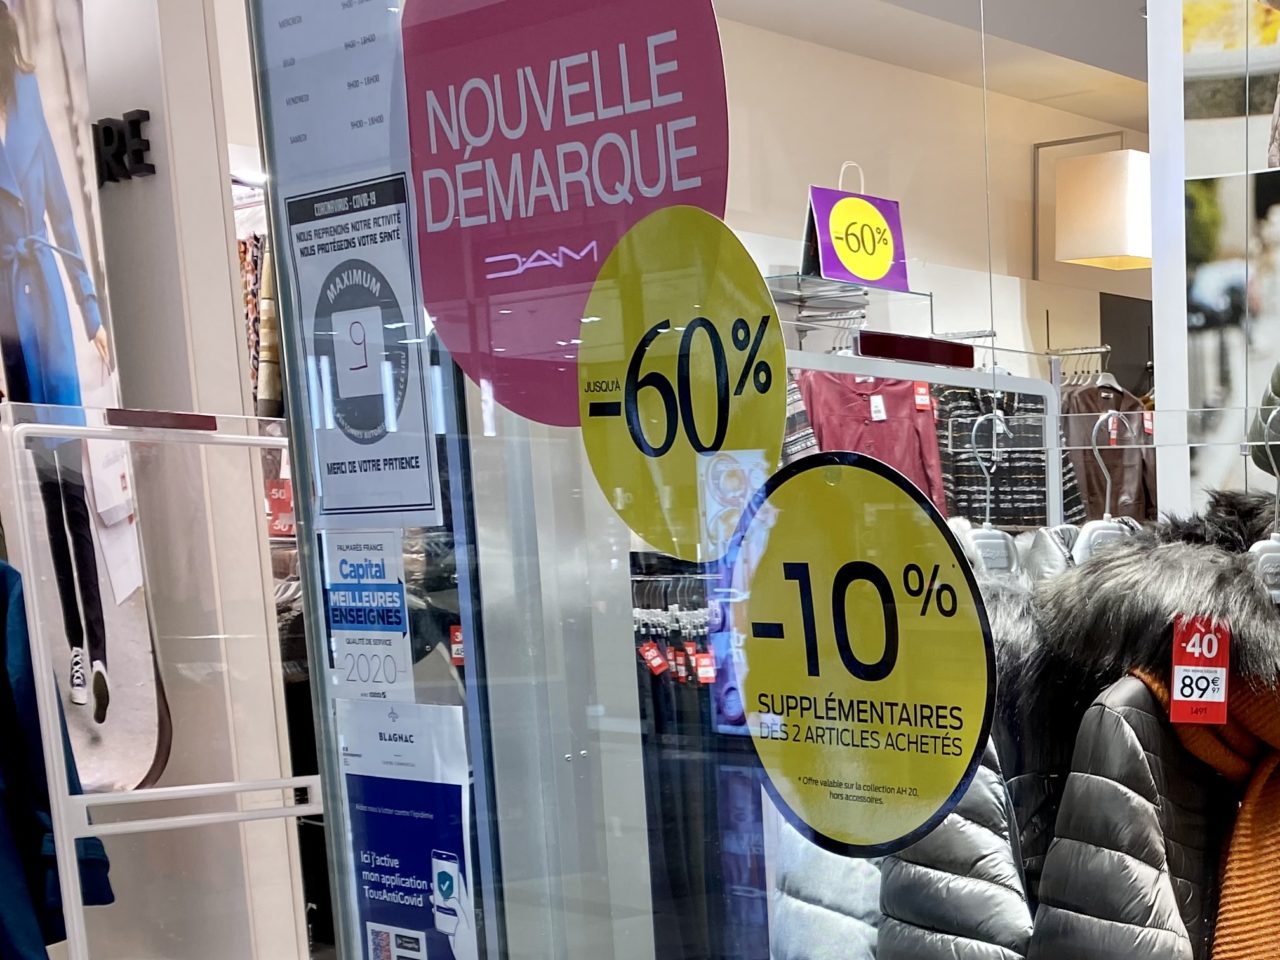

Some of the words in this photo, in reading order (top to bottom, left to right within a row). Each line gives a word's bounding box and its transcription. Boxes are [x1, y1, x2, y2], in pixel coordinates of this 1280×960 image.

[425, 29, 683, 155] NOUVELLE
[92, 108, 156, 189] RE
[422, 115, 702, 233] DÉMARQUE
[314, 197, 349, 217] CORONAVIRUS
[353, 191, 377, 209] COVID-19
[296, 230, 313, 243] NOUS
[314, 223, 350, 239] REPRENONS
[351, 218, 372, 232] NOTRE
[373, 209, 401, 228] ACTIVITÉ
[834, 221, 888, 257] -60%
[300, 245, 316, 257] NOUS
[317, 238, 356, 254] PROTÉGEONS
[358, 232, 378, 247] VOTRE
[379, 226, 400, 243] SANTÉ
[326, 269, 381, 304] MAXIMUM
[349, 321, 368, 371] 9
[584, 377, 621, 393] JUSQU'À
[588, 315, 772, 458] -60%
[327, 461, 347, 475] MERCI
[349, 460, 357, 473] DE
[358, 458, 381, 473] VOTRE
[383, 456, 420, 472] PATIENCE
[337, 543, 362, 551] PALMARÈS
[363, 543, 384, 551] FRANCE
[339, 558, 385, 584] Capital
[329, 591, 401, 607] MEILLEURES
[331, 608, 402, 626] ENSEIGNES
[752, 560, 958, 682] -10%
[345, 653, 397, 684] 2020
[758, 692, 963, 731] SUPPLÉMENTAIRES
[378, 732, 414, 744] BLAGNAC
[760, 718, 789, 741] DÈS
[792, 725, 801, 742] 2
[804, 726, 880, 749] ARTICLES
[884, 731, 963, 756] ACHETÉS
[803, 777, 819, 786] Offre
[820, 779, 843, 788] valable
[844, 782, 854, 790] sur
[855, 782, 861, 790] la
[863, 784, 895, 794] collection
[896, 786, 906, 794] AH
[829, 791, 843, 800] hors
[360, 851, 371, 863] Ici
[362, 871, 379, 882] mon
[381, 873, 427, 890] application
[363, 886, 424, 907] TousAntiCovid
